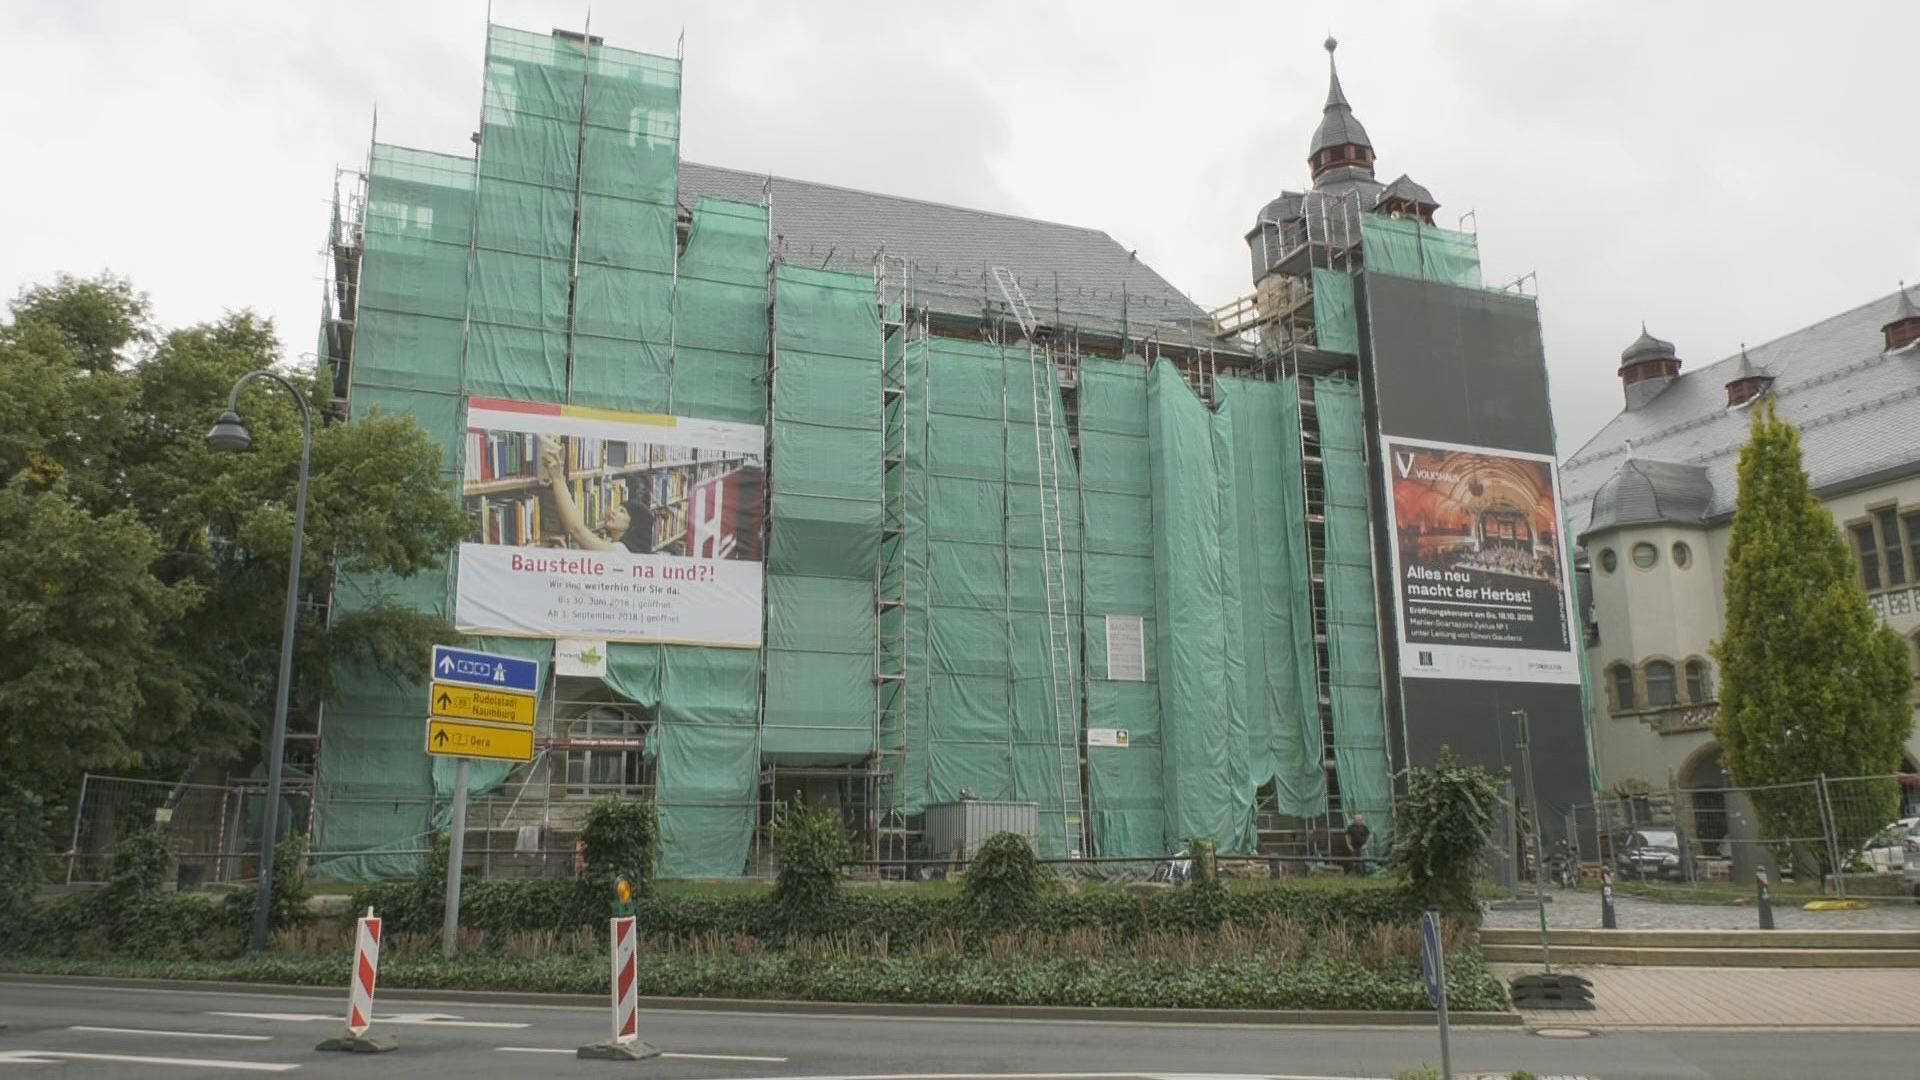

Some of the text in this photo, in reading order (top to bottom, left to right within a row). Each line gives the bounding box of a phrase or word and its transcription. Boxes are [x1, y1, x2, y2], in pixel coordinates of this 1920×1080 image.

[511, 554, 605, 576] Baustelle
[632, 565, 654, 578] na
[662, 563, 715, 582] und?!
[1407, 565, 1471, 582] Alles neu
[584, 581, 629, 592] weiterhin
[633, 583, 647, 593] für
[649, 584, 664, 594] Sie
[666, 585, 680, 595] da.
[1407, 584, 1532, 603] macht der Herbst!
[548, 609, 559, 618] Ab
[572, 610, 615, 621] September
[618, 612, 638, 621] 2018
[472, 704, 516, 721] Naumburg
[470, 735, 491, 747] Gera
